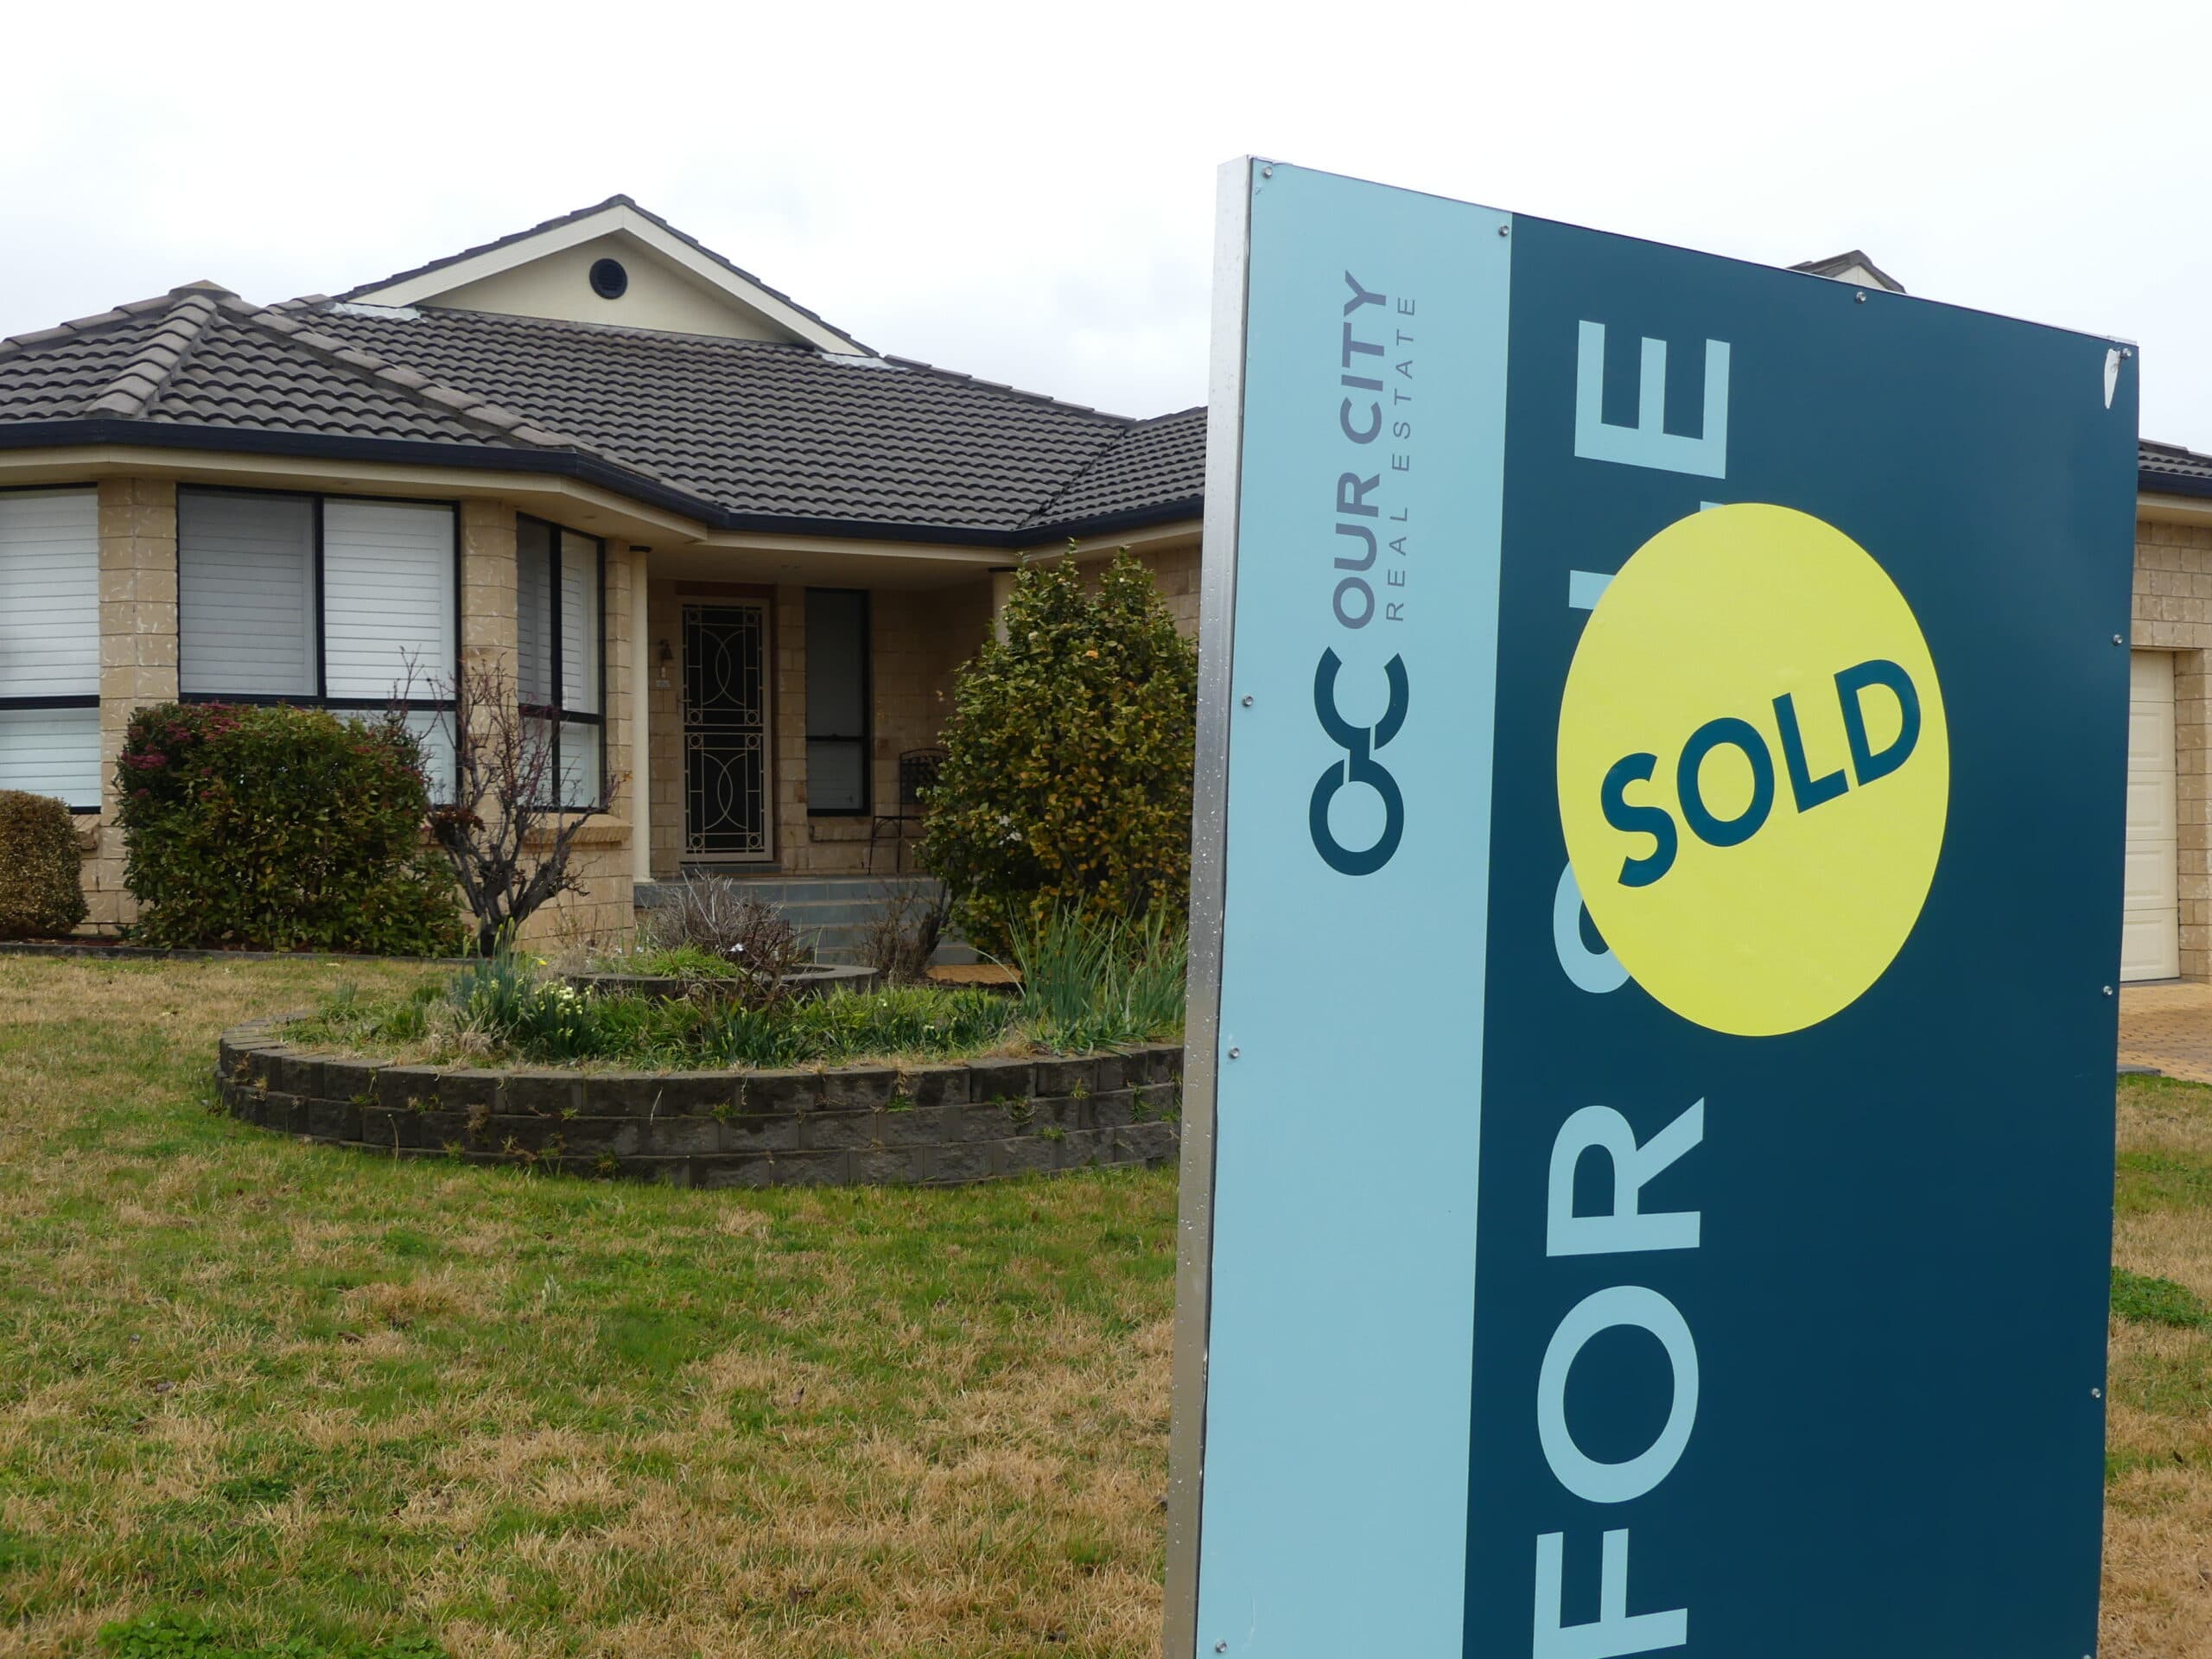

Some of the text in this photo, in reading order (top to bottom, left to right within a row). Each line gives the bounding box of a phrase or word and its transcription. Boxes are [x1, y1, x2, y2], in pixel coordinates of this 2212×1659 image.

[1332, 270, 1387, 630] OUR CITY
[1385, 296, 1416, 622] REAL ESTATE
[1600, 658, 1922, 888] SOLD
[1532, 1096, 1705, 1659] FOR
